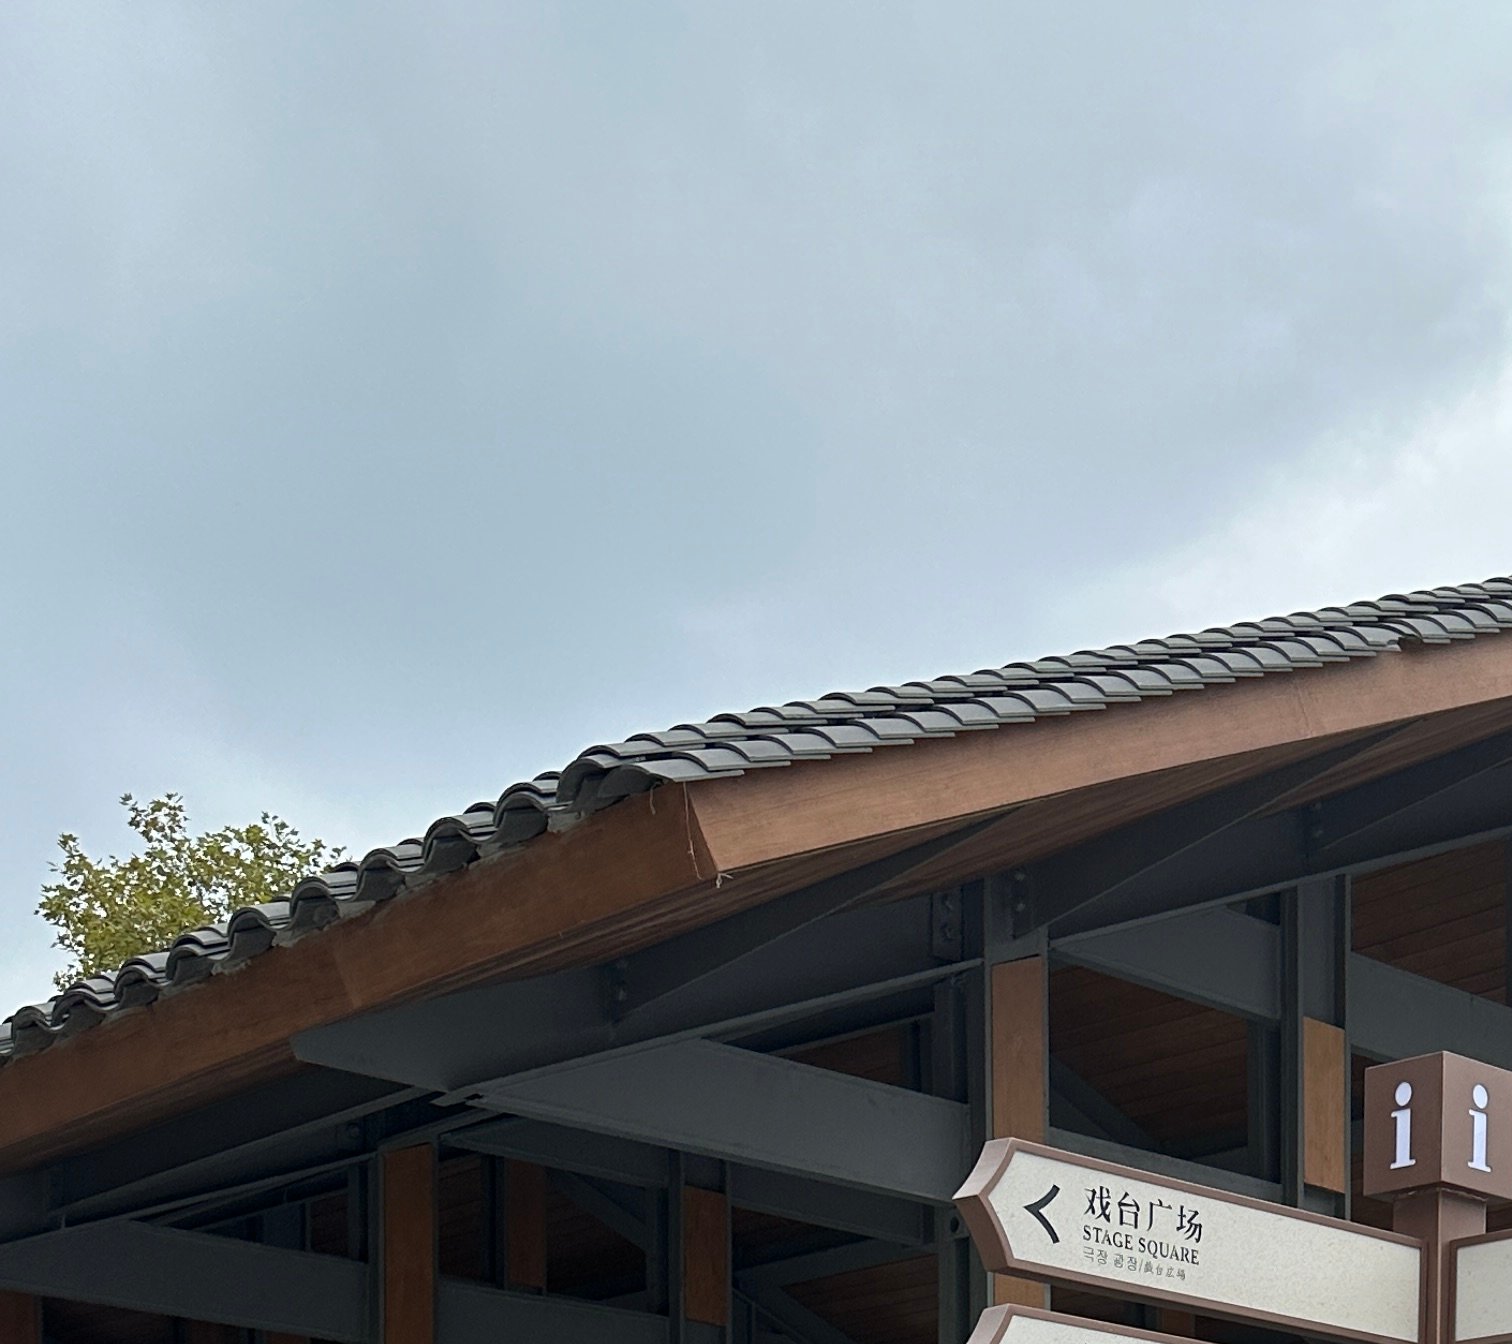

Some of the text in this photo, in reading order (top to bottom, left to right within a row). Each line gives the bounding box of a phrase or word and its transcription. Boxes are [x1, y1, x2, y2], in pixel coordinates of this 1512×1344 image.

[1083, 1185, 1203, 1244] 戏台广场
[1082, 1224, 1200, 1266] STAGE SQUARE
